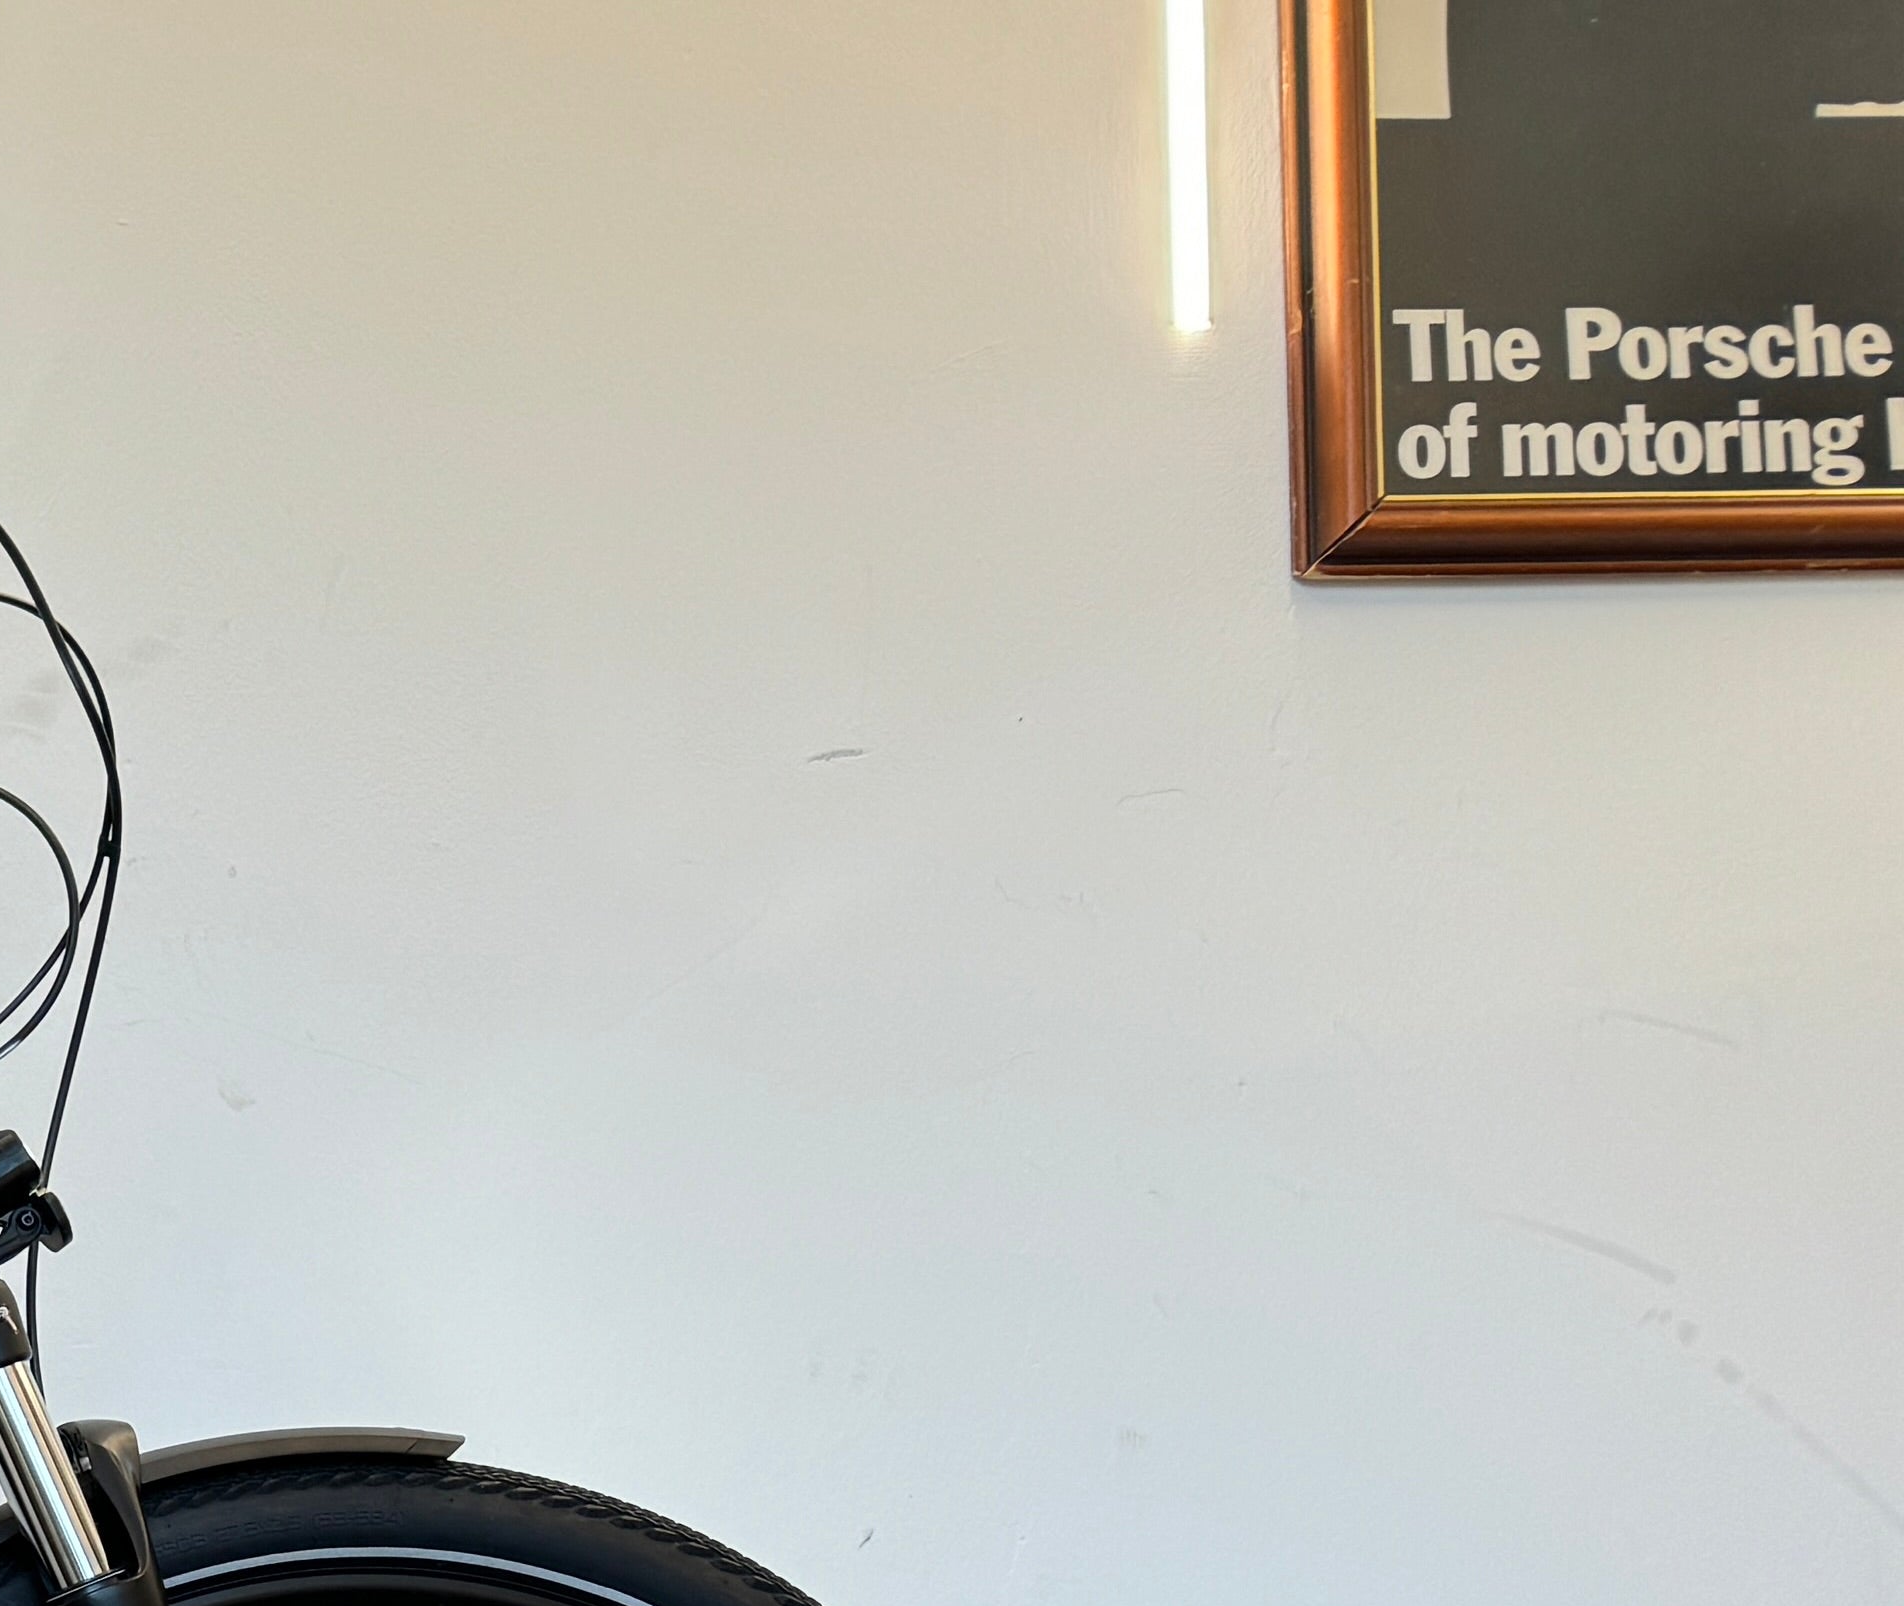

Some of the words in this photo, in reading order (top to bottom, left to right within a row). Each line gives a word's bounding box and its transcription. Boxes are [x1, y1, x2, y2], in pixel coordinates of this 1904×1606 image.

[1391, 308, 1542, 383] The
[1564, 304, 1894, 381] Porsche
[1397, 402, 1478, 479] of
[1500, 399, 1865, 487] motoring
